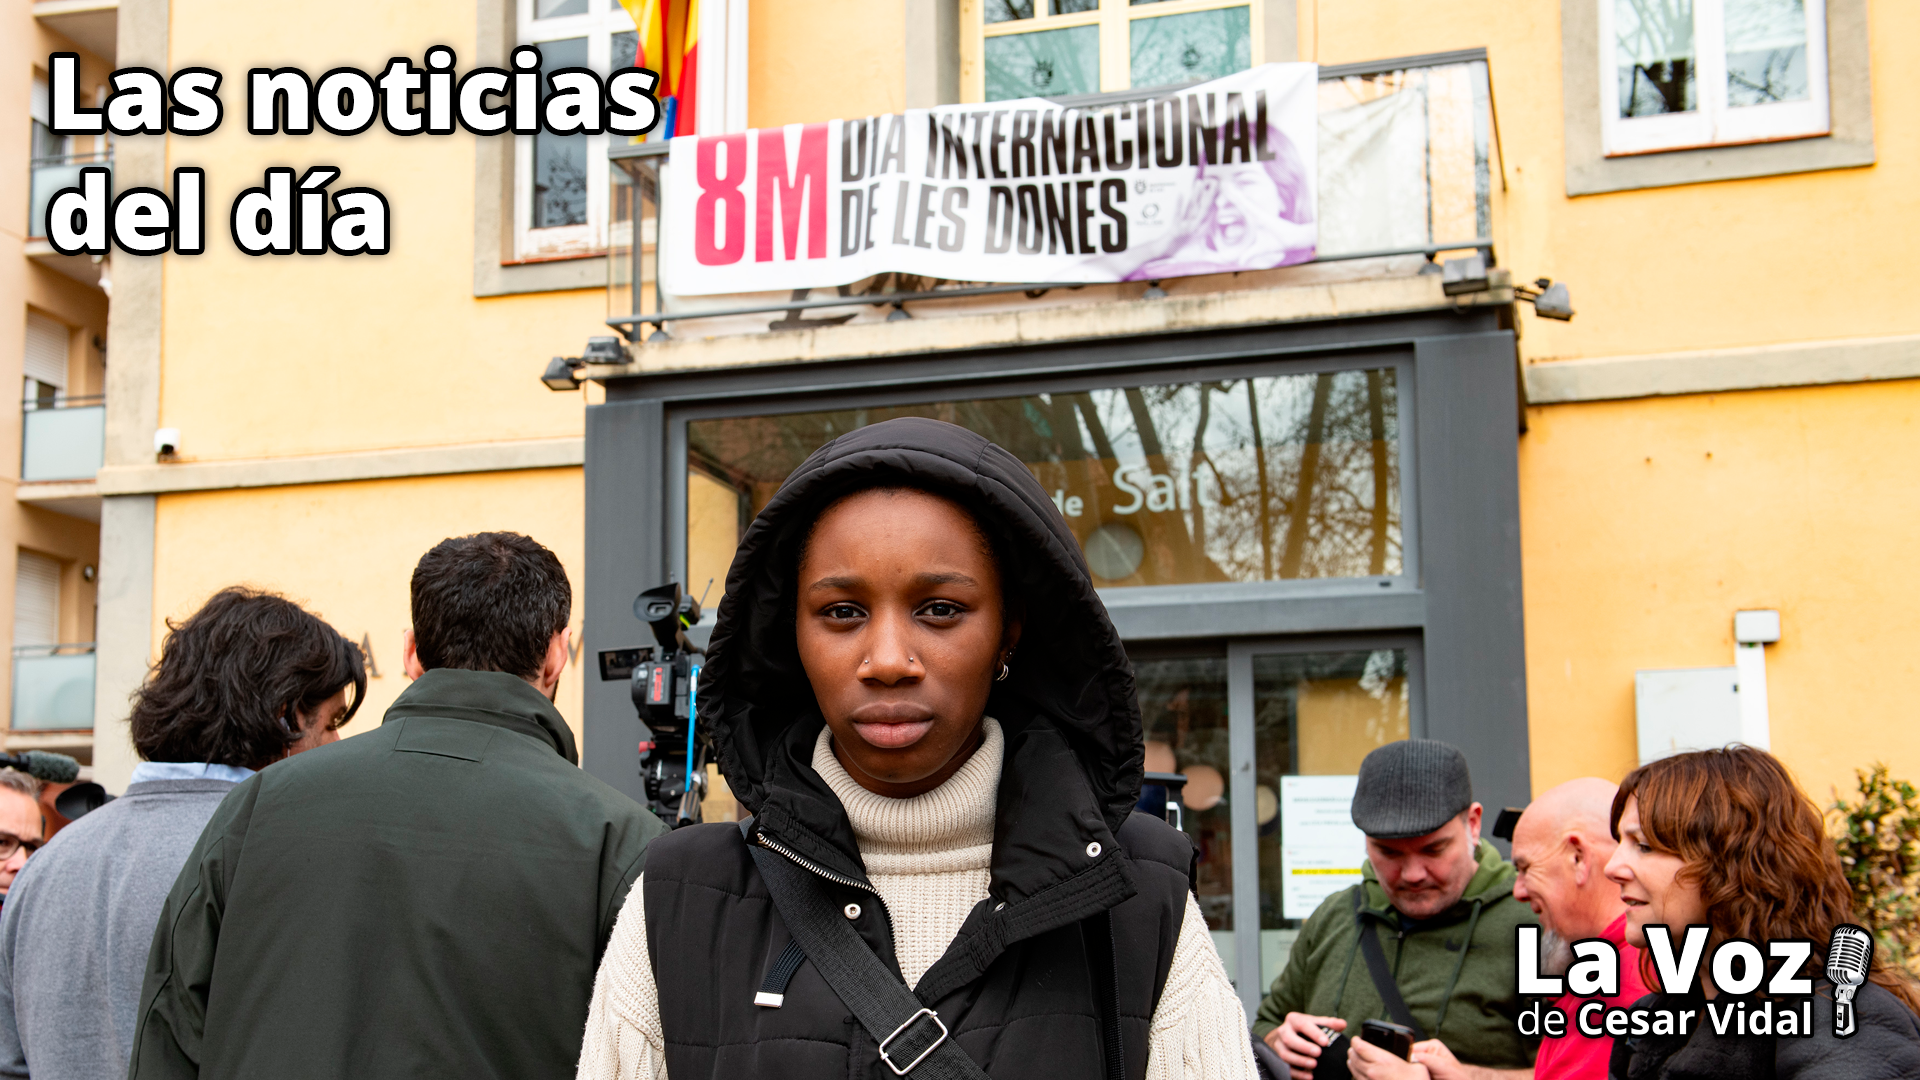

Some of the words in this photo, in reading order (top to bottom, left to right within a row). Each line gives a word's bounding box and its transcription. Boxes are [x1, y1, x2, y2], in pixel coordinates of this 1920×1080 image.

[925, 89, 1276, 180] INTERNACIONAL
[695, 124, 829, 266] 8M
[840, 182, 880, 258] DE
[892, 180, 969, 253] LES
[984, 178, 1128, 255] DONES
[1112, 462, 1216, 515] Salt
